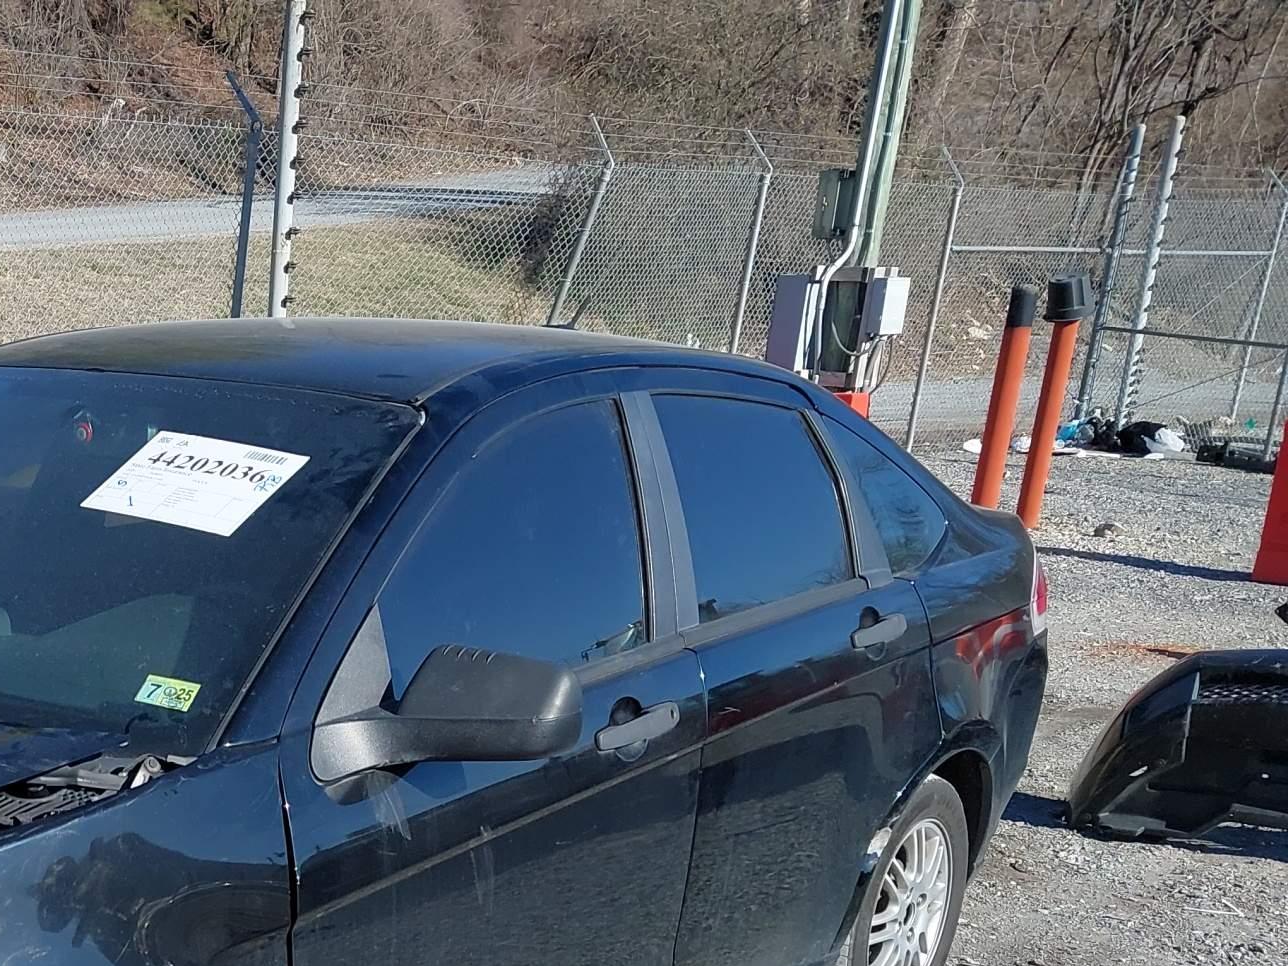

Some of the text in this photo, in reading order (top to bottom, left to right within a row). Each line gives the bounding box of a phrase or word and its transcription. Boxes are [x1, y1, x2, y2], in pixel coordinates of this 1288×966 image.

[148, 450, 272, 483] 44202036
[147, 683, 194, 702] 7 25
